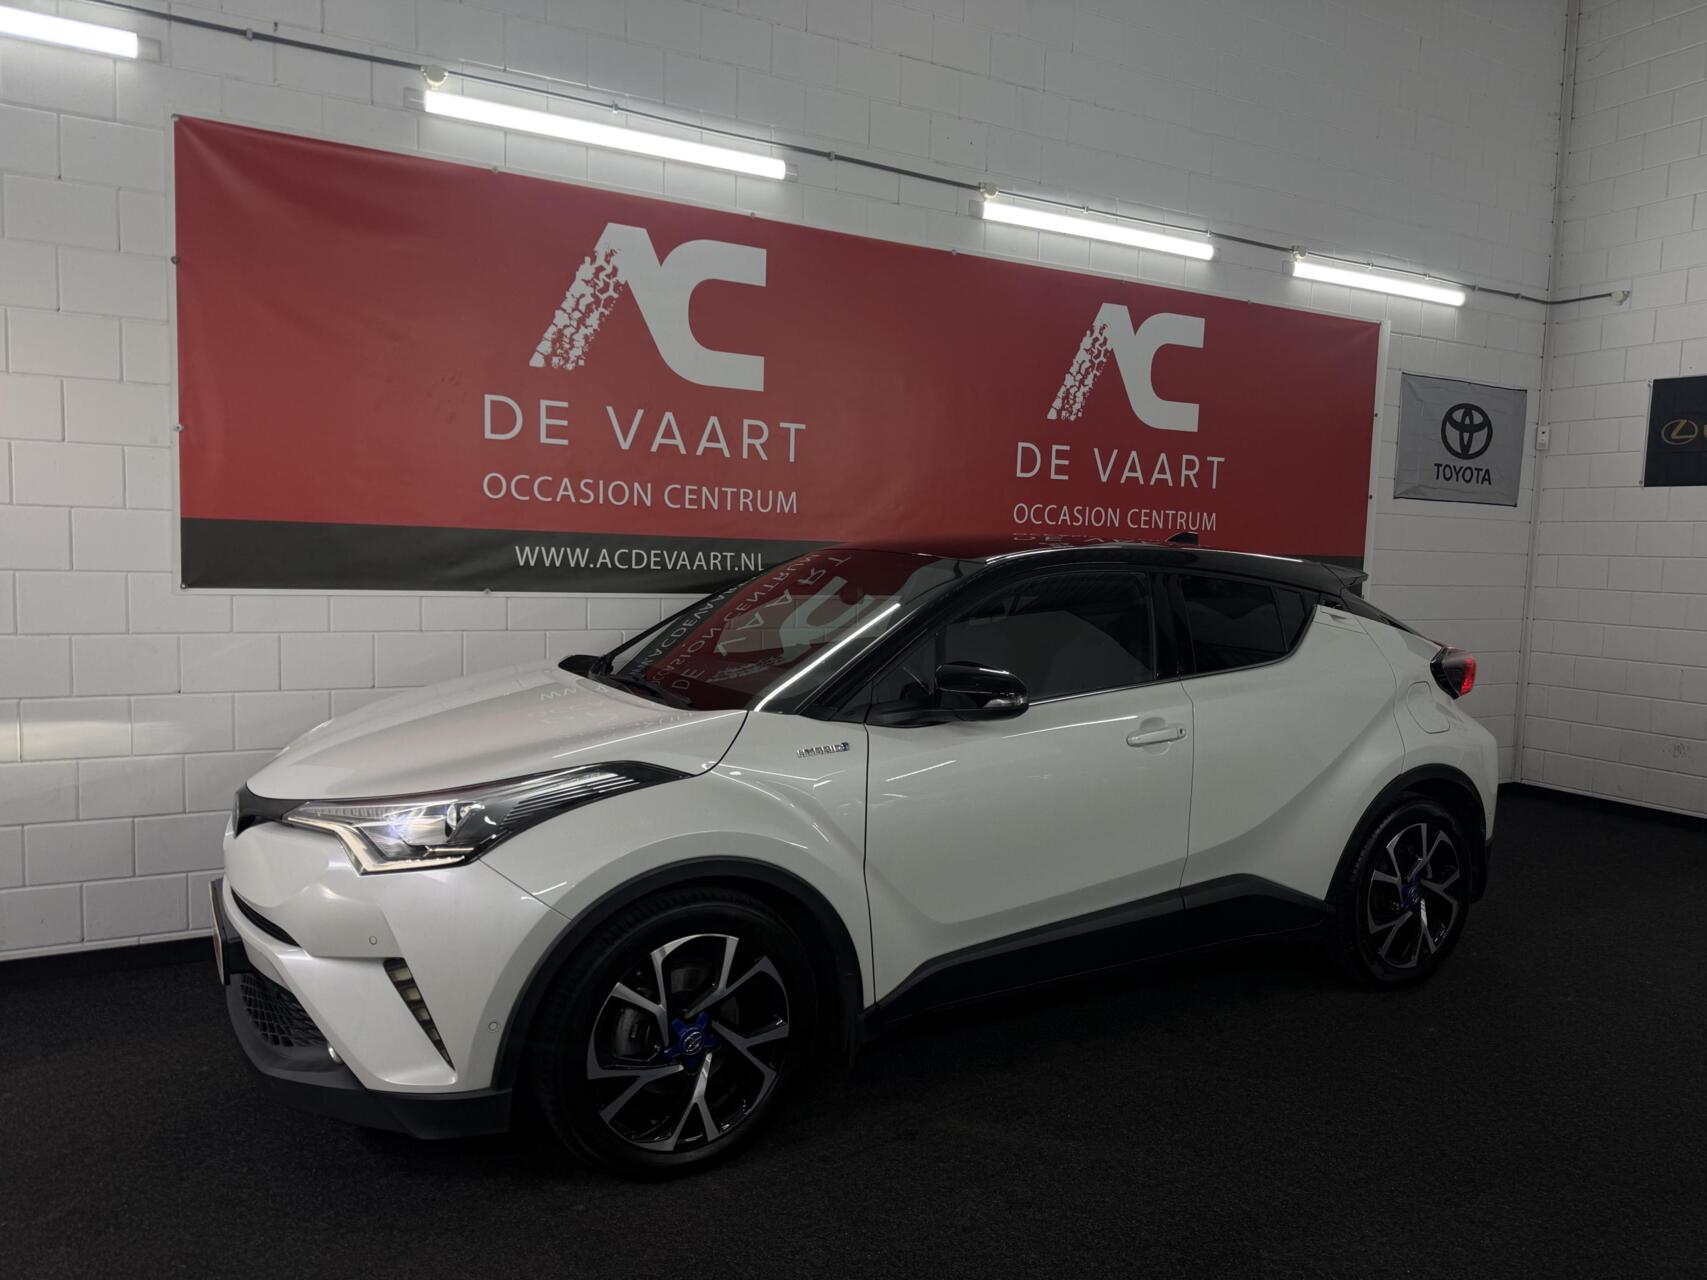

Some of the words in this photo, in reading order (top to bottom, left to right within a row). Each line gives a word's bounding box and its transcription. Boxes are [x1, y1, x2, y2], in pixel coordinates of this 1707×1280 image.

[484, 394, 569, 445] DE
[606, 405, 806, 462] VAART
[1016, 442, 1070, 480] DE
[1093, 447, 1225, 489] VAART
[1433, 462, 1492, 486] TOYOTA
[482, 472, 652, 507] OCCASION
[663, 484, 798, 514] CENTRUM
[1013, 503, 1120, 528] OCCASION
[1127, 508, 1217, 531] CENTRUM
[514, 545, 764, 572] WWW.ACDEVAART.NL
